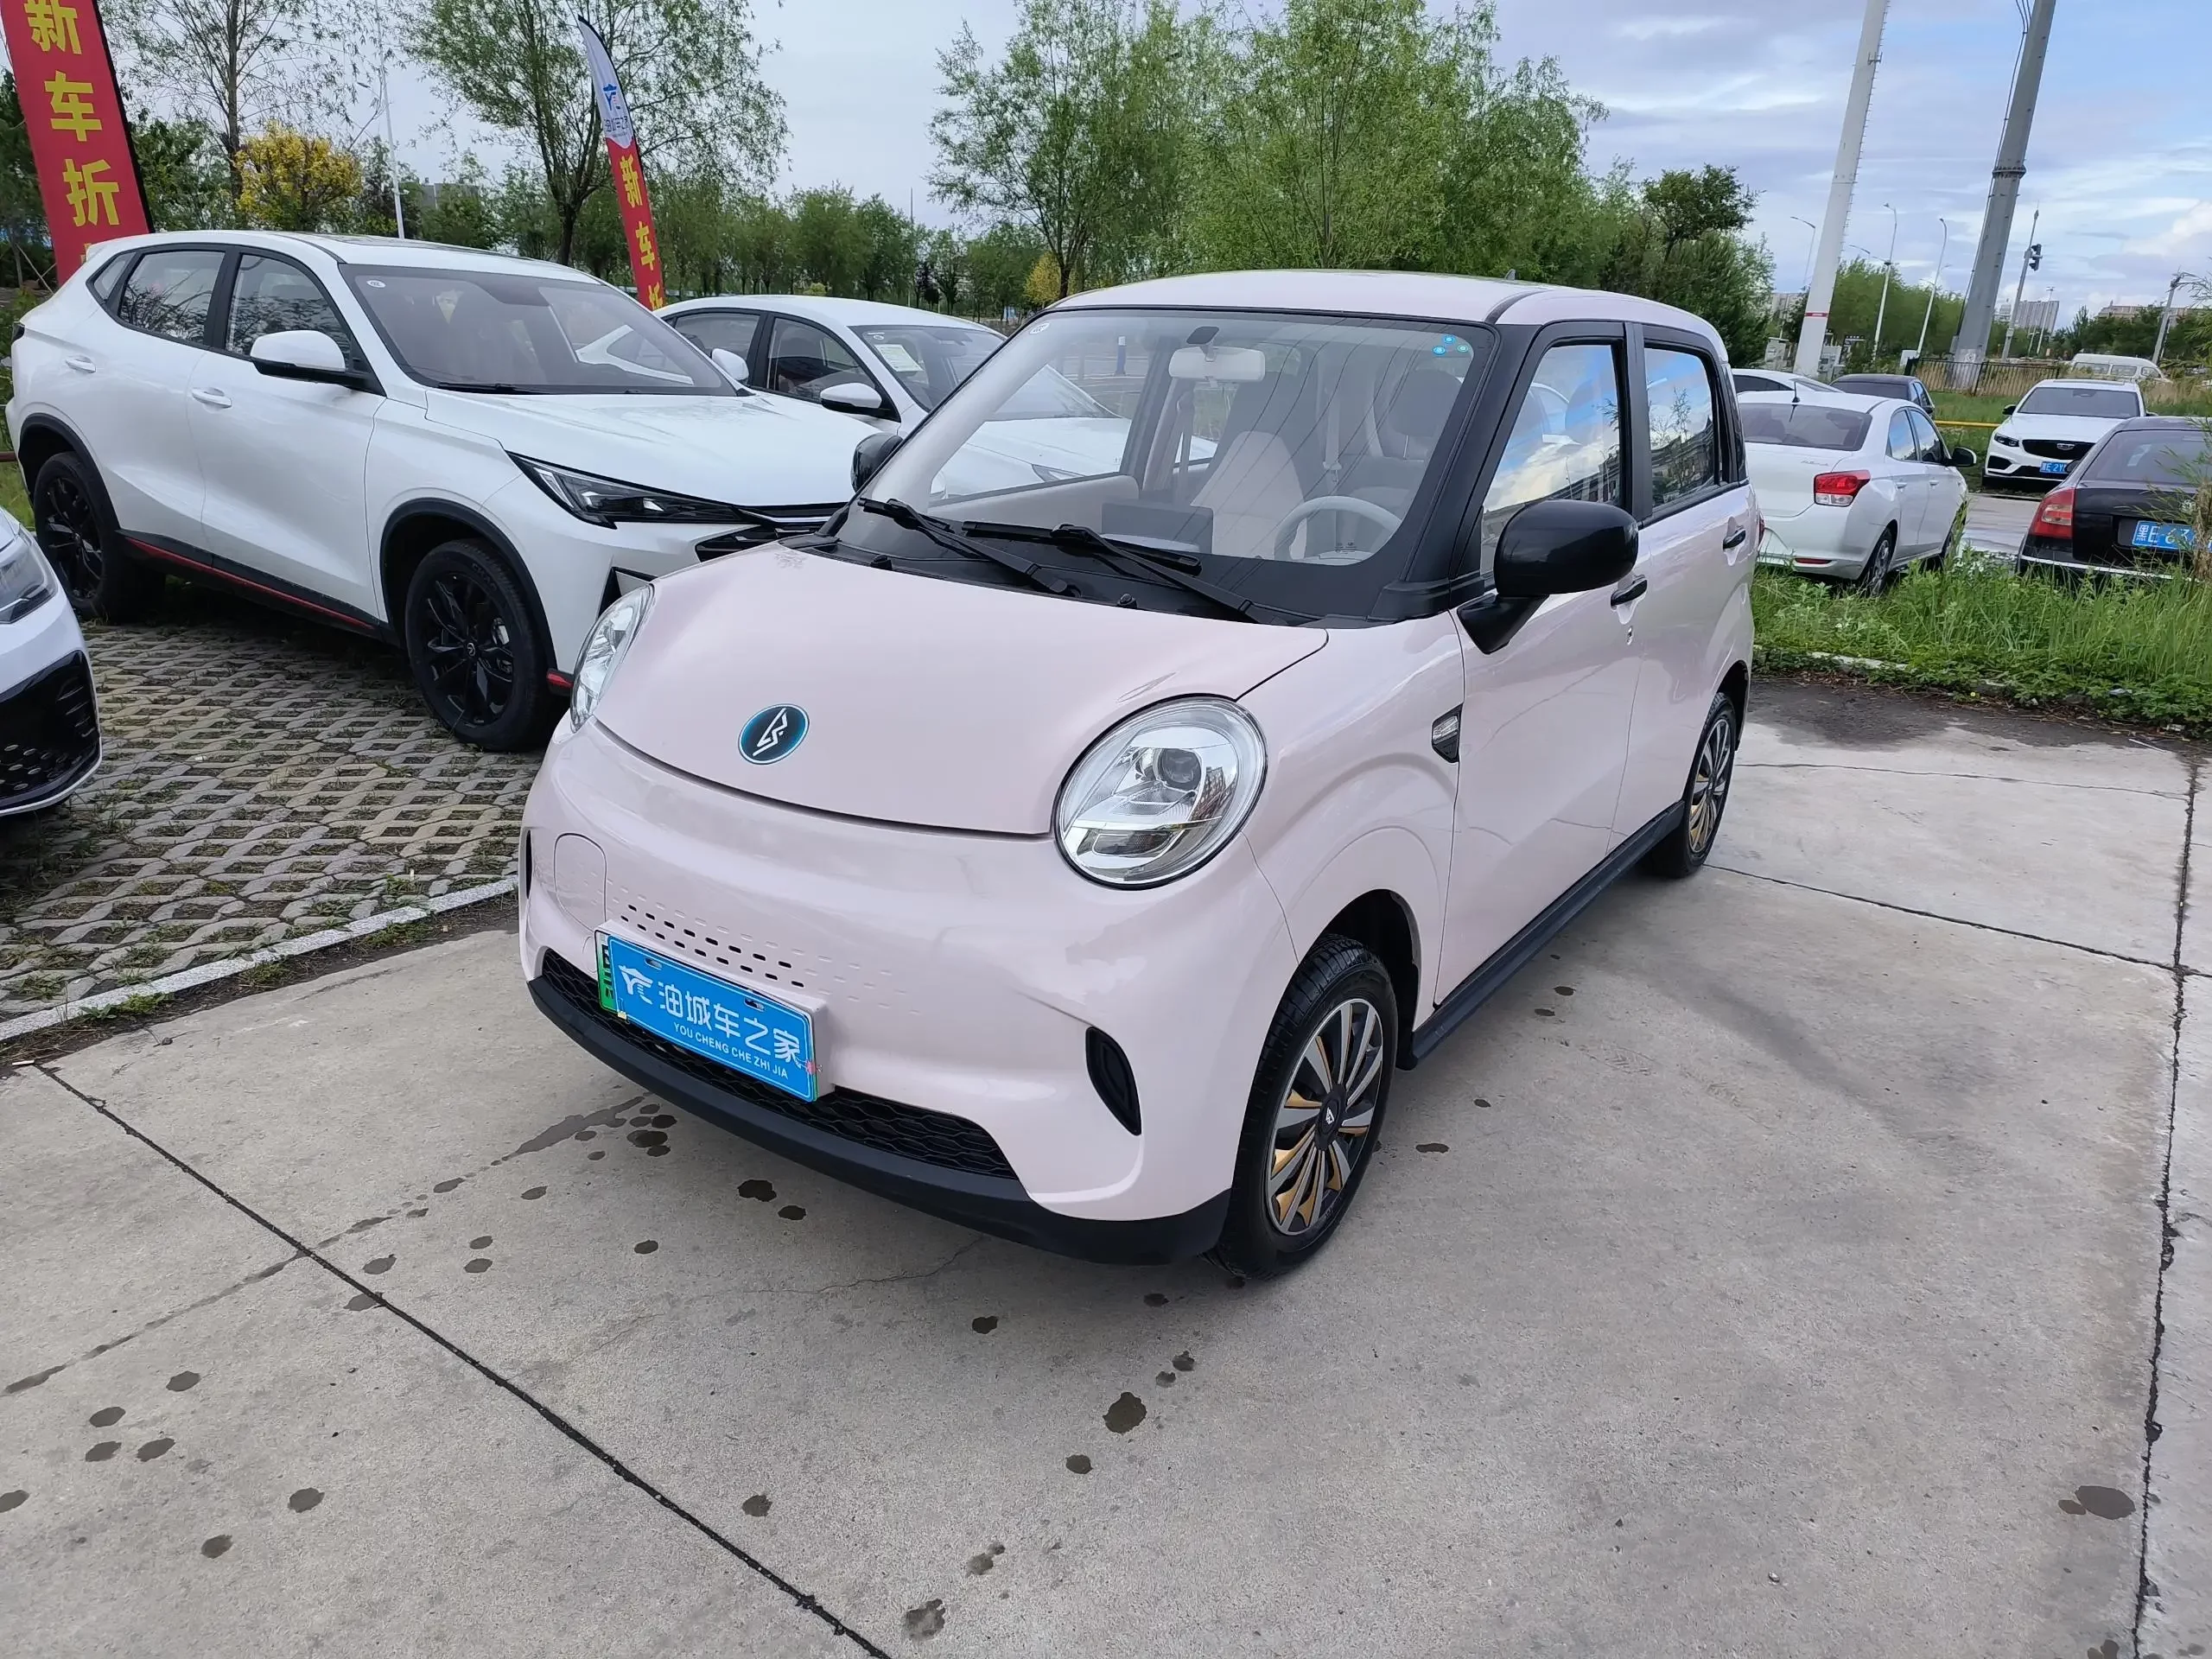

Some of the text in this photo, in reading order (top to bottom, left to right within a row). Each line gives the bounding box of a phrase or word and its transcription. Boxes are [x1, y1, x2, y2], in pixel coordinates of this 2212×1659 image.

[658, 982, 804, 1069] 油城车之家
[674, 1021, 788, 1080] YOU CHENG CHE ZHI JIA
